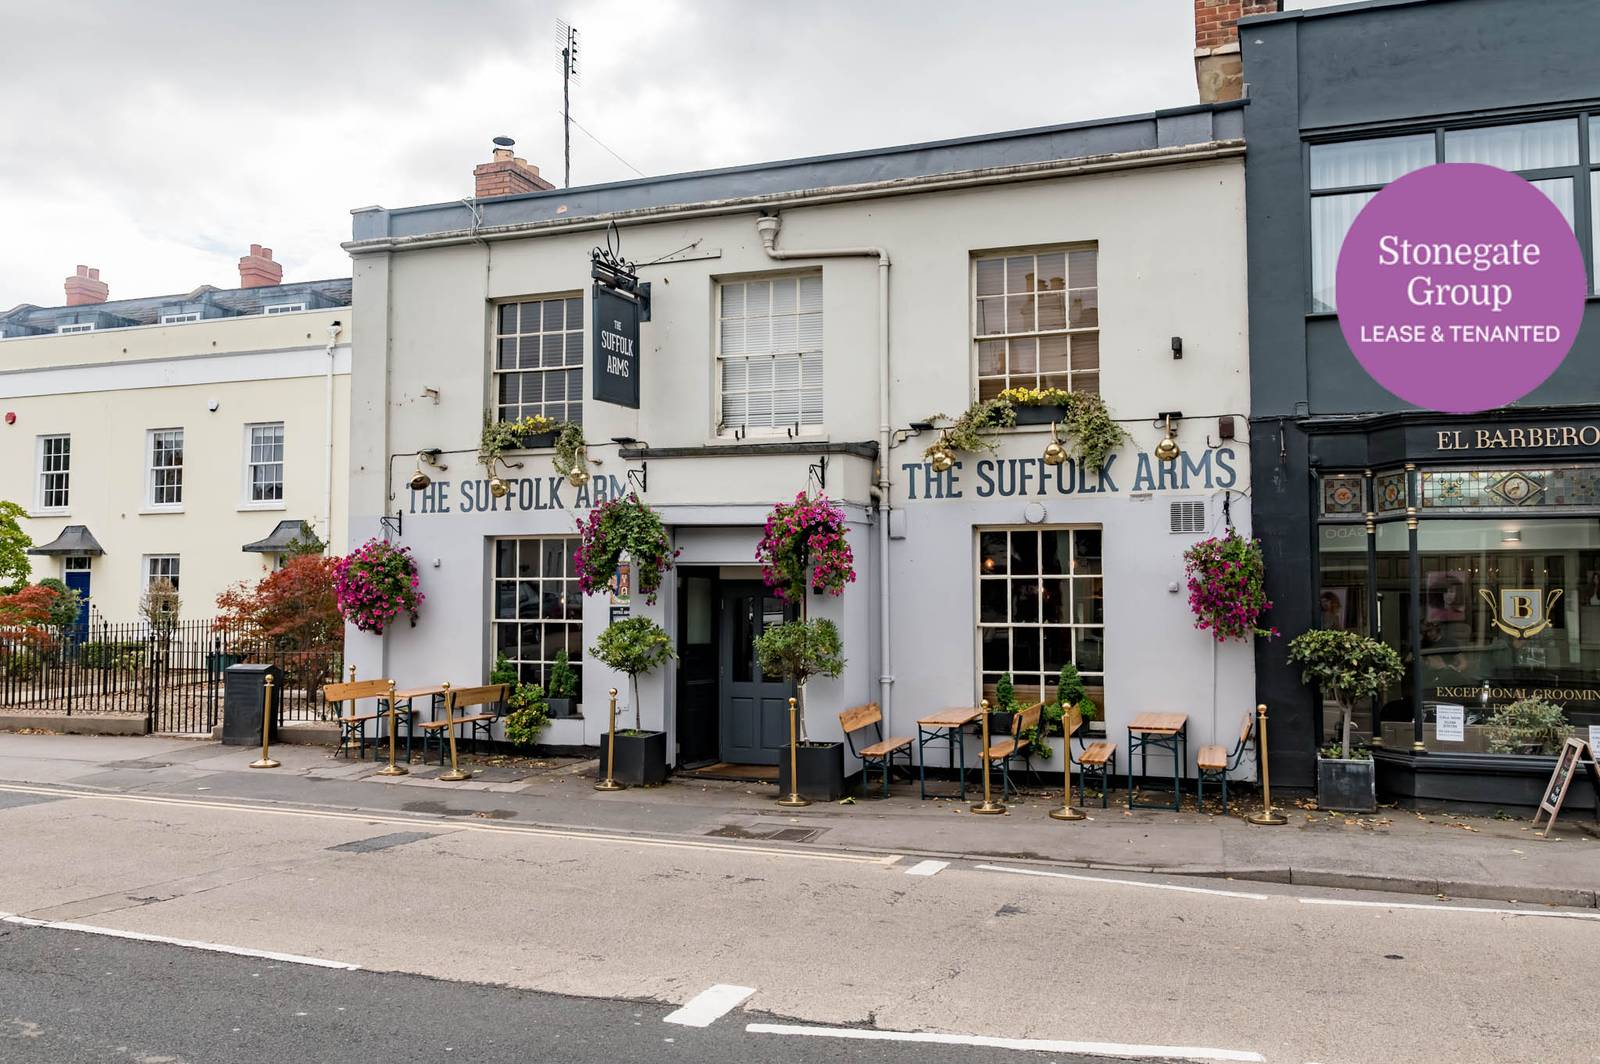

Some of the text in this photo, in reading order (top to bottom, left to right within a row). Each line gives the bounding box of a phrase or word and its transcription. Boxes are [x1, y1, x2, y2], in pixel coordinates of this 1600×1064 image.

[613, 319, 622, 331] THE
[601, 330, 634, 358] SUFFOLK
[606, 354, 629, 378] ARMS
[1436, 425, 1600, 450] EL BARBERO
[902, 448, 1237, 499] THE SUFFOLK ARMS
[405, 481, 451, 514] THE
[1510, 595, 1534, 619] B
[1436, 686, 1530, 699] EXCEPTIONAL
